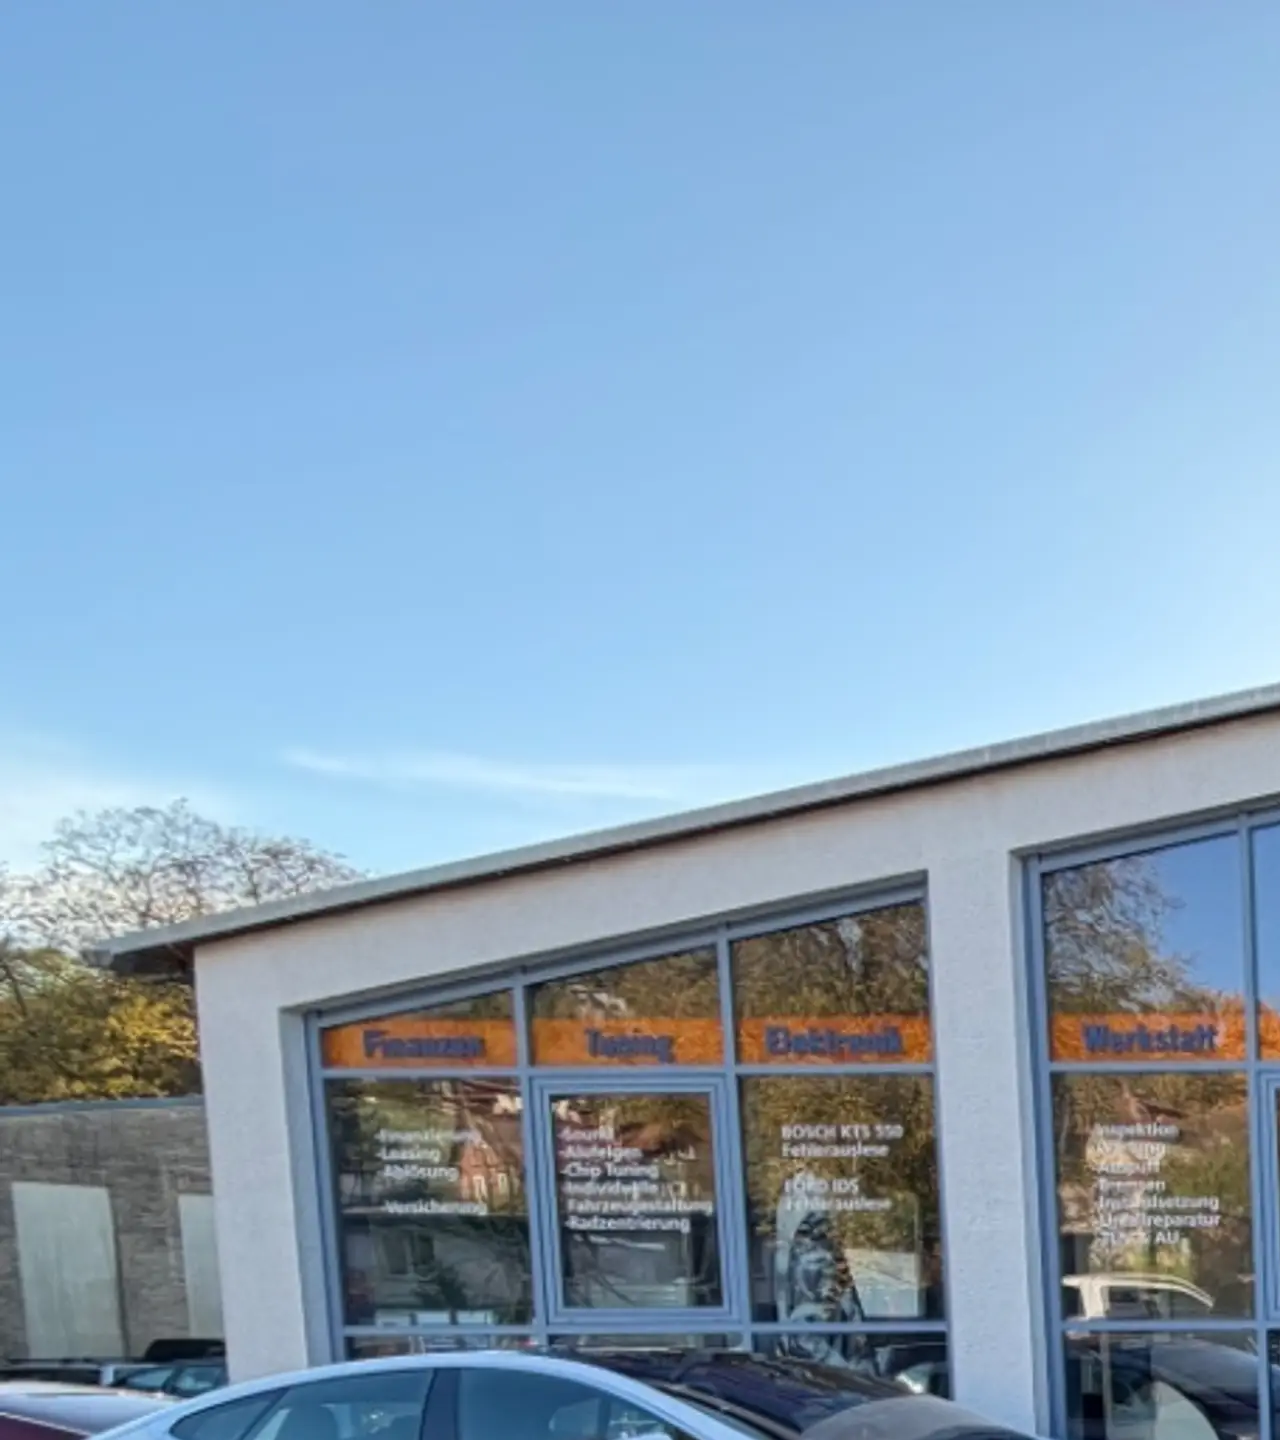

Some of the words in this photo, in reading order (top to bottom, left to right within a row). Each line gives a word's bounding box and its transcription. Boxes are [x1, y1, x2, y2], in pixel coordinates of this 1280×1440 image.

[363, 1030, 487, 1058] Finanzen
[586, 1029, 675, 1063] Tuning
[766, 1027, 902, 1057] Elektronik
[1082, 1022, 1218, 1051] Werkstatt
[604, 1163, 659, 1179] Tuning
